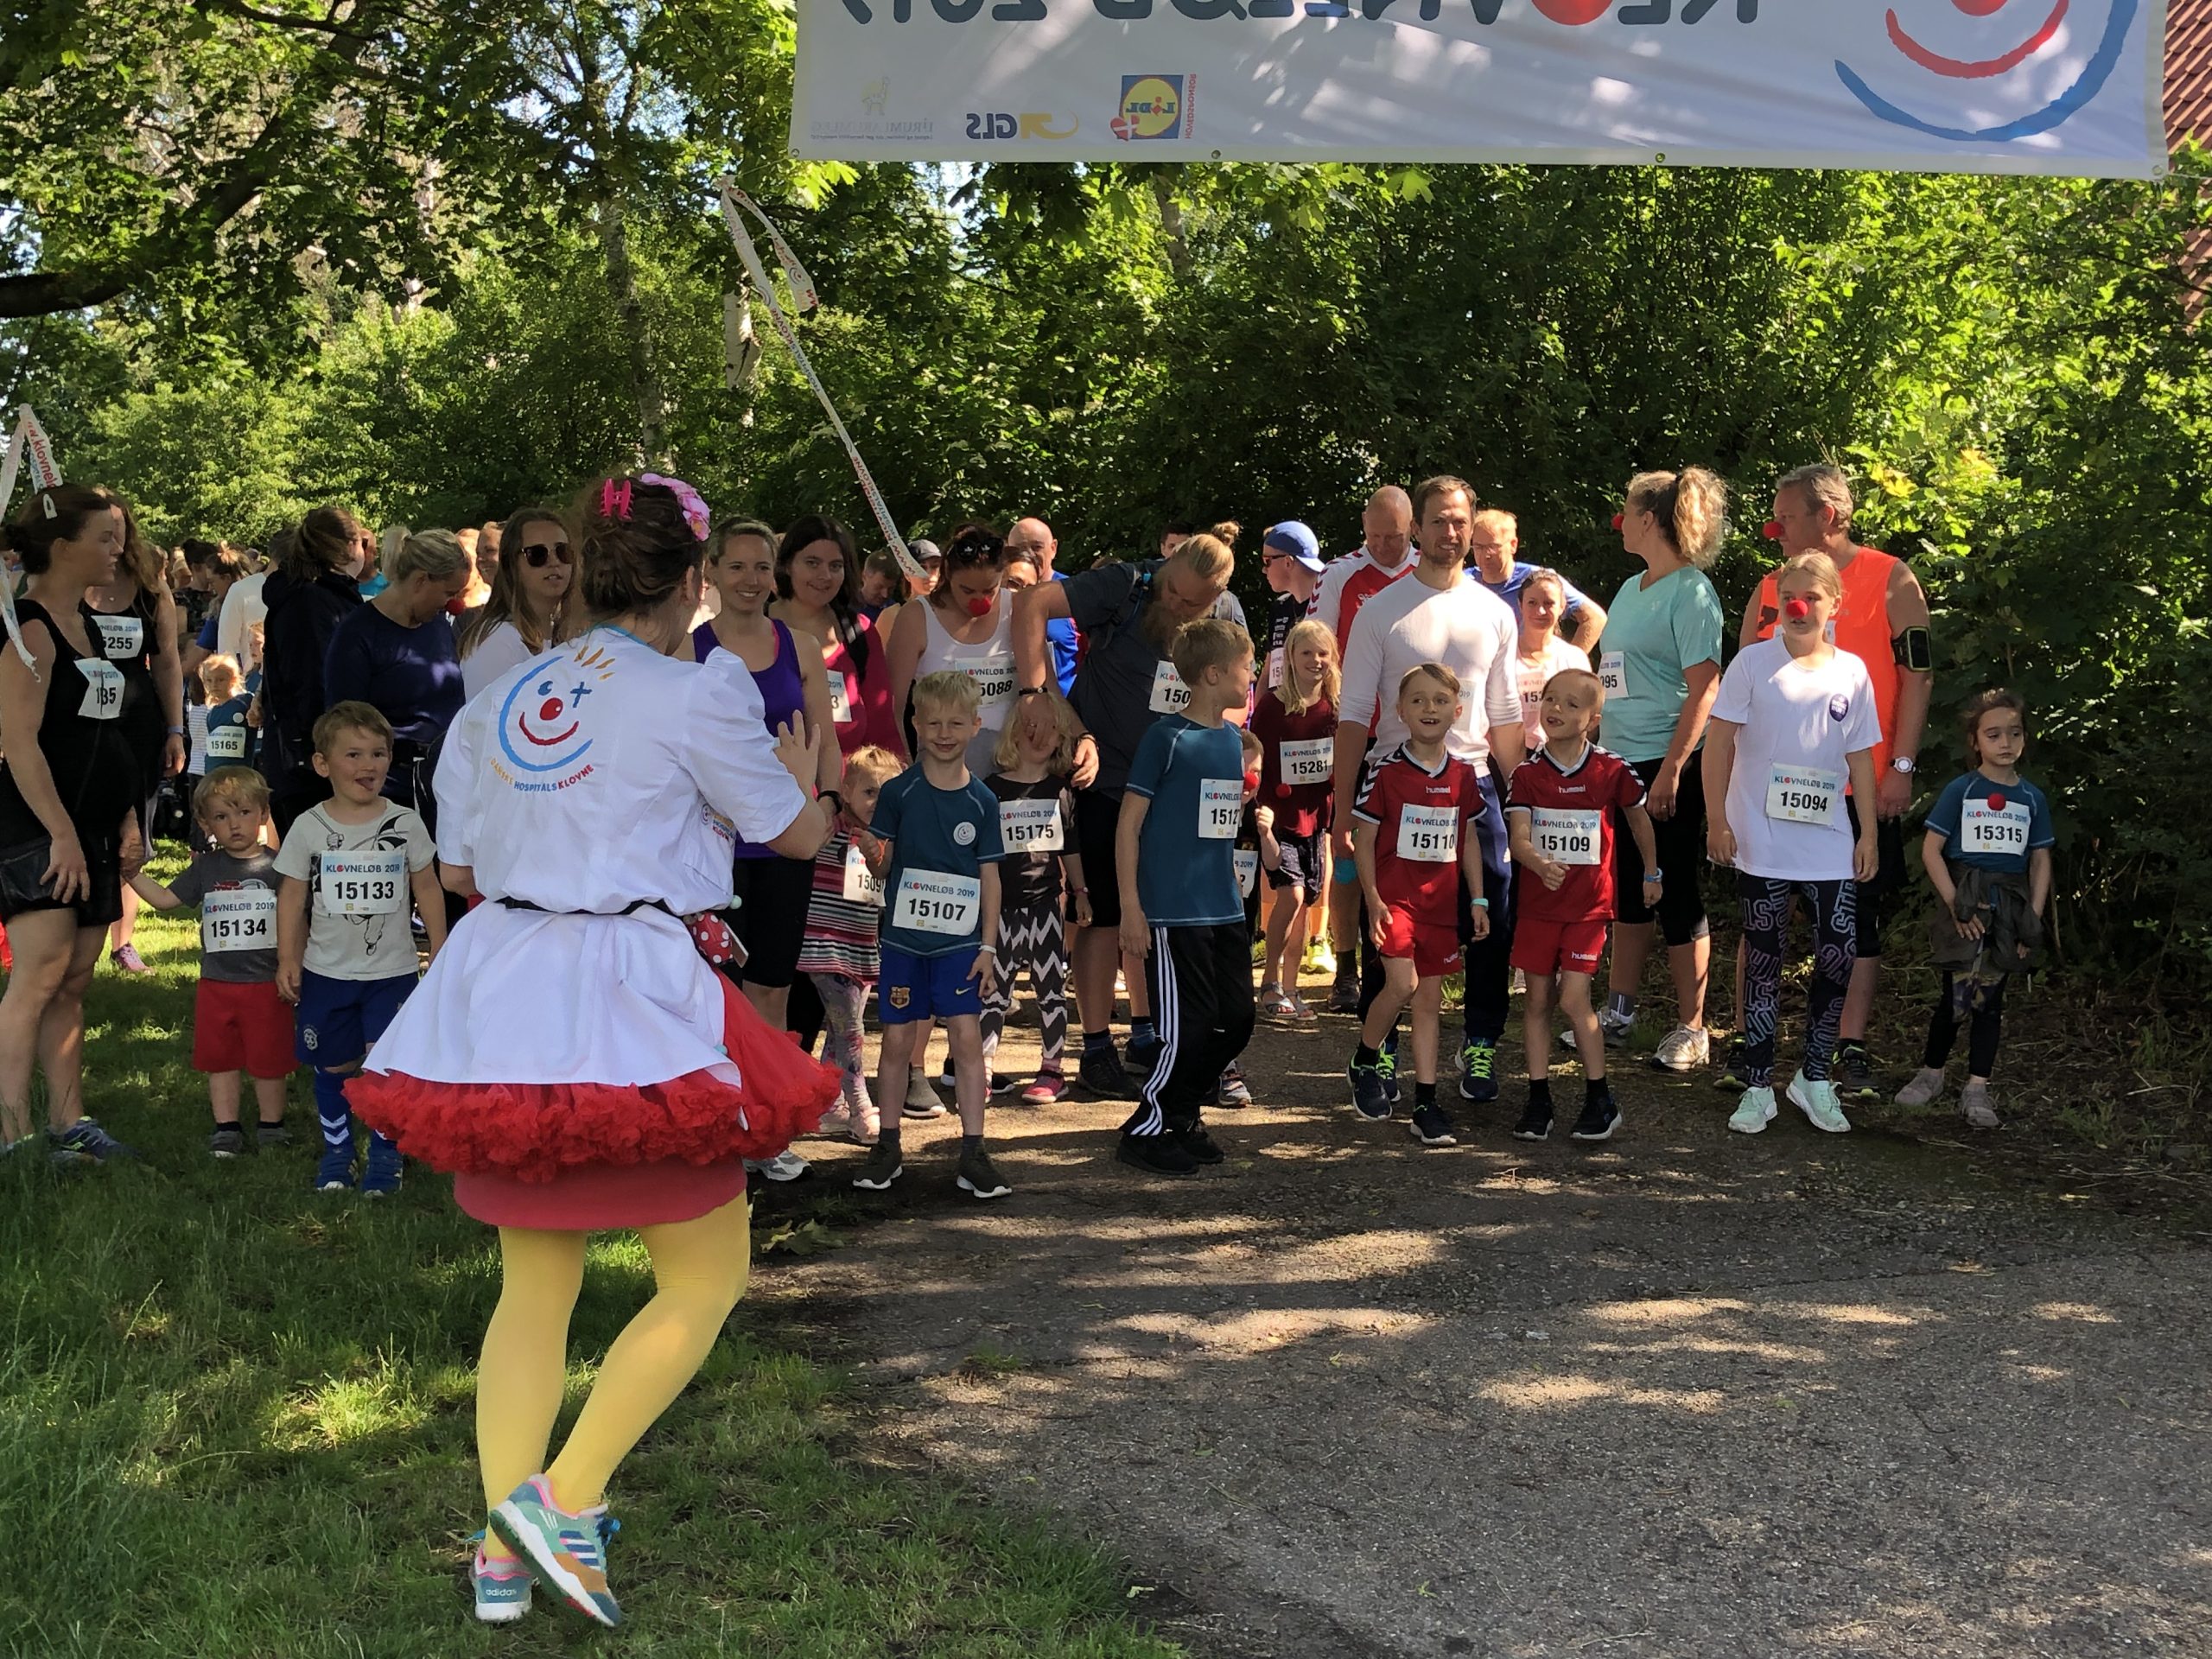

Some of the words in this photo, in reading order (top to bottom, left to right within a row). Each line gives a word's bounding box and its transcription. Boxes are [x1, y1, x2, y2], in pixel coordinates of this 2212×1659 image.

[102, 637, 133, 650] 5255
[980, 679, 1014, 696] 5088
[1164, 687, 1192, 704] 150
[211, 740, 238, 750] 15165
[1290, 759, 1328, 775] 15281
[1774, 775, 1821, 789] KLOVNELØB
[1781, 791, 1828, 812] 15094
[1406, 816, 1450, 827] KLOVNELØB
[1967, 810, 2013, 820] KLOVNELØB
[1006, 823, 1054, 842] 15175
[1534, 819, 1579, 830] KLOVNELØB
[1580, 820, 1597, 830] 2019
[1411, 832, 1455, 849] 15110
[1974, 824, 2023, 843] 15315
[1540, 834, 1590, 852] 15109
[326, 863, 382, 874] KLOVNELØB
[334, 881, 395, 899] 15133
[903, 880, 955, 896] KLOVNELØB
[957, 888, 976, 898] 2019
[205, 902, 252, 914] KLOVNELØB
[255, 902, 276, 911] 2019
[909, 898, 967, 922] 15107
[211, 918, 268, 938] 15134
